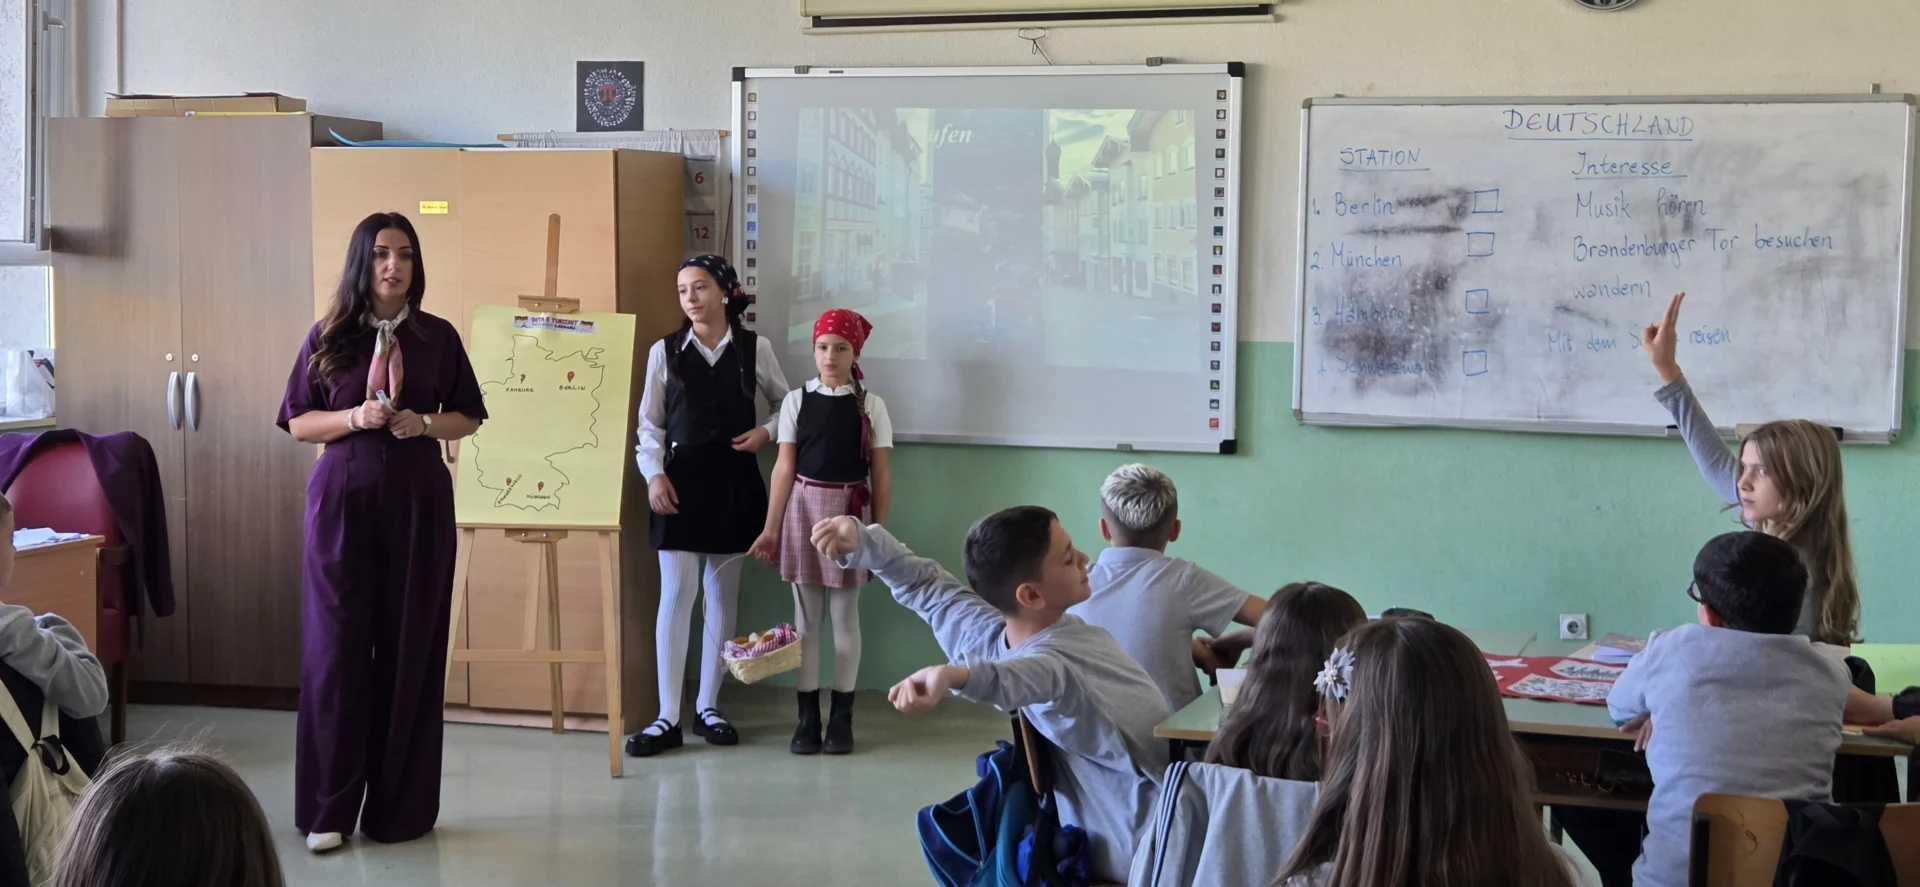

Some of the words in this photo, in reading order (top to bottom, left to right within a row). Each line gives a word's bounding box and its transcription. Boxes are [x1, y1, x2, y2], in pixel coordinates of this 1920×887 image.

[1502, 109, 1694, 137] DEUTSCHLAND
[1339, 147, 1421, 167] STATION
[1571, 151, 1673, 176] Interesse
[694, 171, 705, 184] 6
[1334, 191, 1396, 217] Berlin
[1575, 189, 1633, 219] Musik
[1656, 186, 1709, 217] hören
[693, 227, 711, 239] 12
[1572, 233, 1697, 269] Brandenburger
[1703, 227, 1740, 252] Tor
[1754, 223, 1833, 250] besuchen
[1310, 251, 1325, 271] 2.
[1331, 241, 1403, 268] München
[1571, 275, 1652, 299] wandern
[1312, 306, 1324, 326] 3.
[1335, 296, 1408, 332] Hamburg
[1548, 330, 1574, 354] Mit
[1586, 330, 1618, 351] dem
[1689, 325, 1732, 346] reisen
